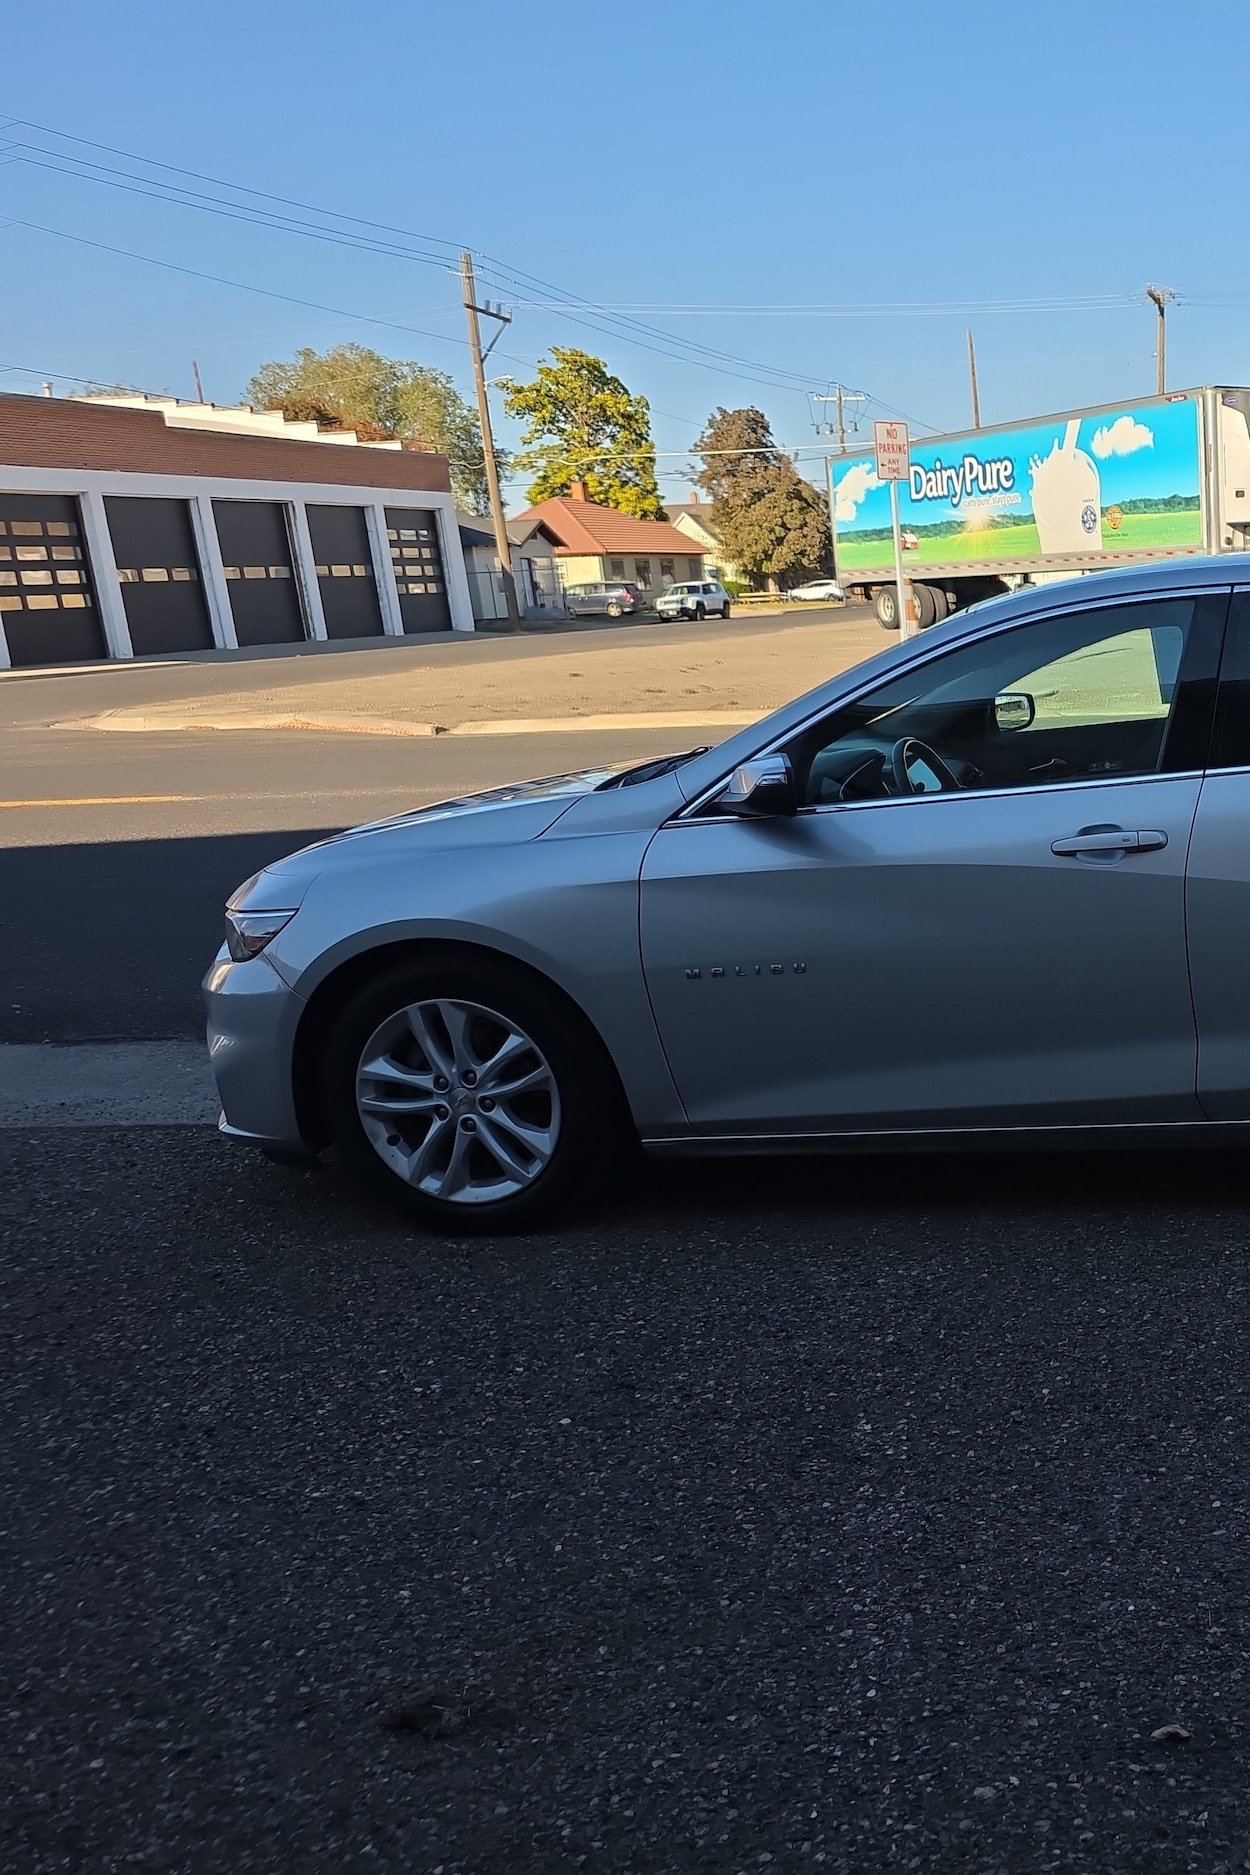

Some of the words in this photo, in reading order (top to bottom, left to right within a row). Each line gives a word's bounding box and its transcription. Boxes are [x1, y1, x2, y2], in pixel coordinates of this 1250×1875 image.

[886, 429, 897, 440] NO
[879, 443, 907, 455] PARKING
[887, 458, 900, 466] ANY
[887, 466, 901, 475] TIME
[910, 455, 1015, 506] DairyPure
[684, 963, 808, 979] MALIBU
